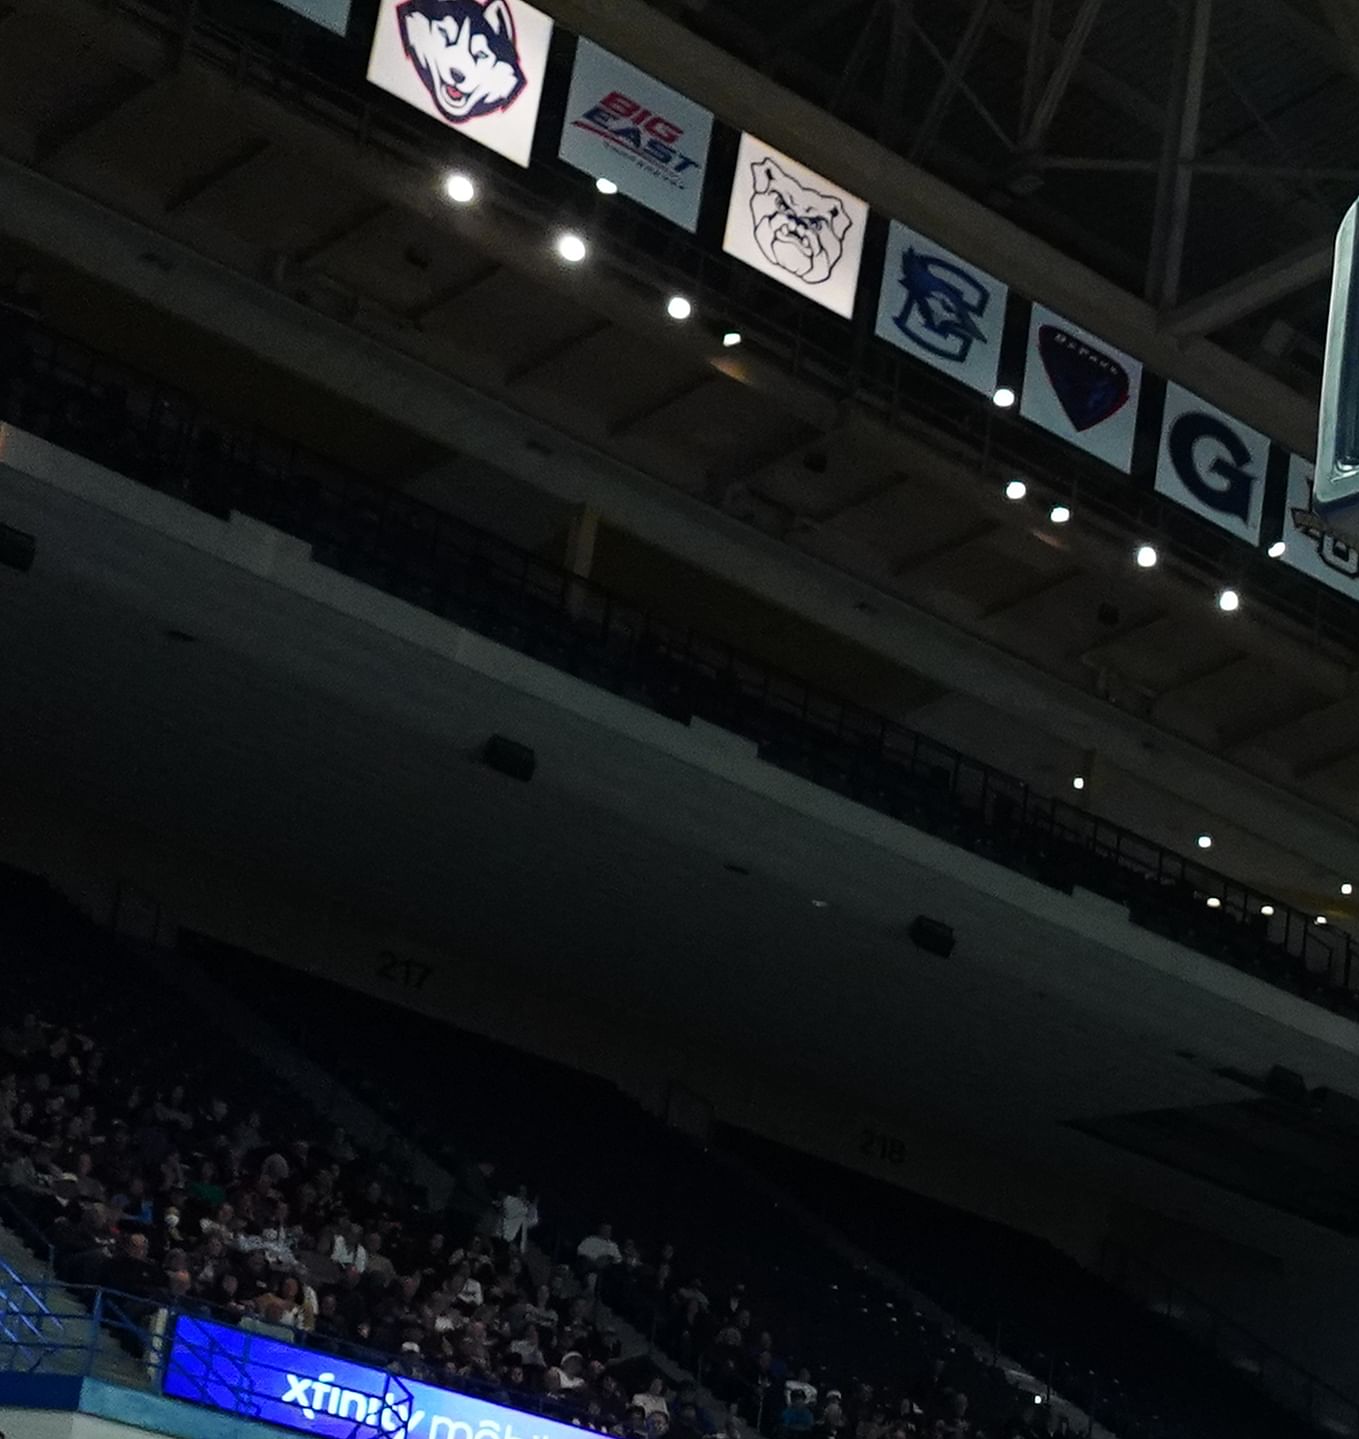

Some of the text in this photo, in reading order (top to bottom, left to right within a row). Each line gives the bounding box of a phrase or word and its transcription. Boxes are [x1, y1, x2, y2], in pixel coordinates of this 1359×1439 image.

[583, 105, 699, 172] EAST
[599, 91, 684, 144] BIG
[1168, 411, 1256, 523] G
